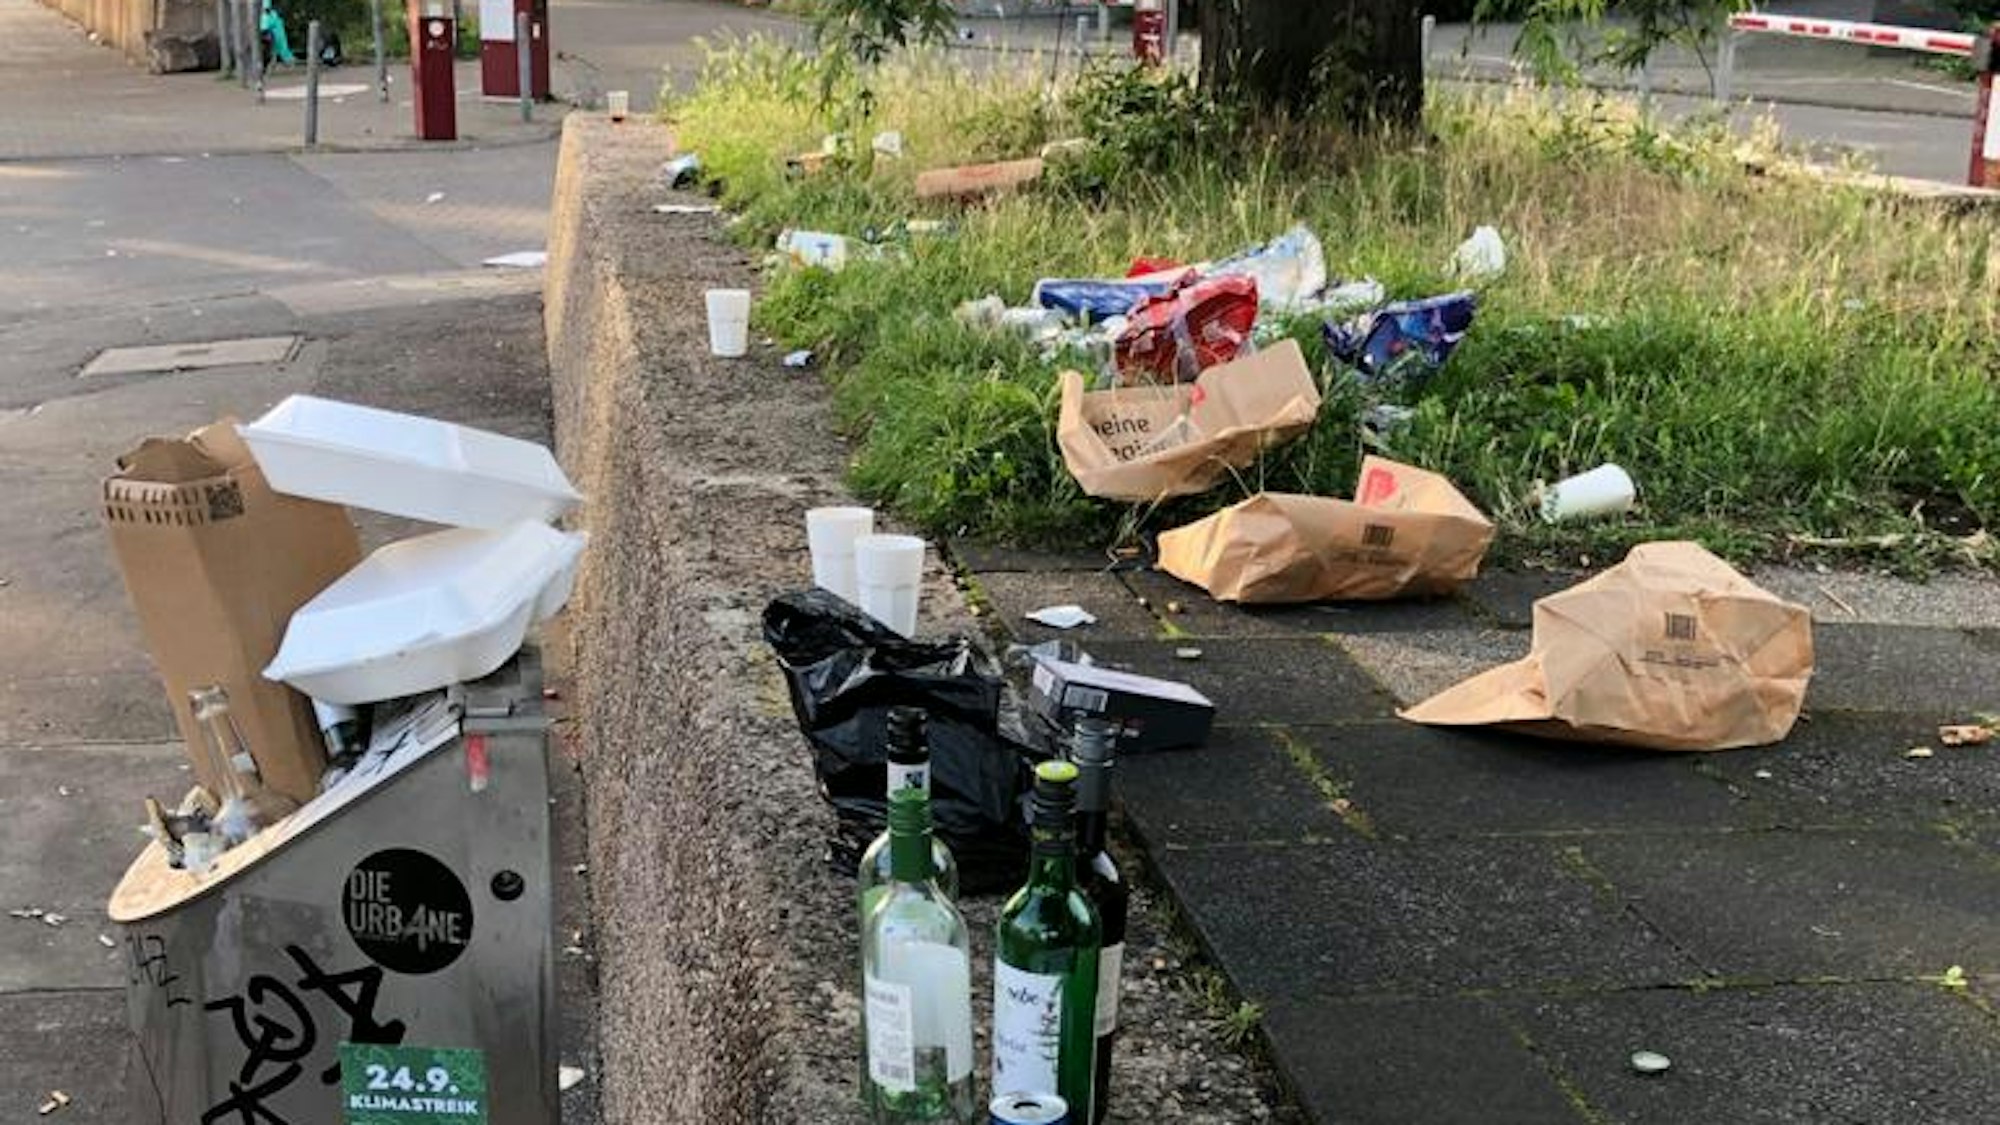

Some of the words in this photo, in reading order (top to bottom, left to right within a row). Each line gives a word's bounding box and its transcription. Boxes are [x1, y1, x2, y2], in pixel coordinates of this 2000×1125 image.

[350, 868, 393, 903] DIE
[365, 1063, 460, 1094] 24.9.
[350, 1094, 478, 1115] KLIMASTREIK
